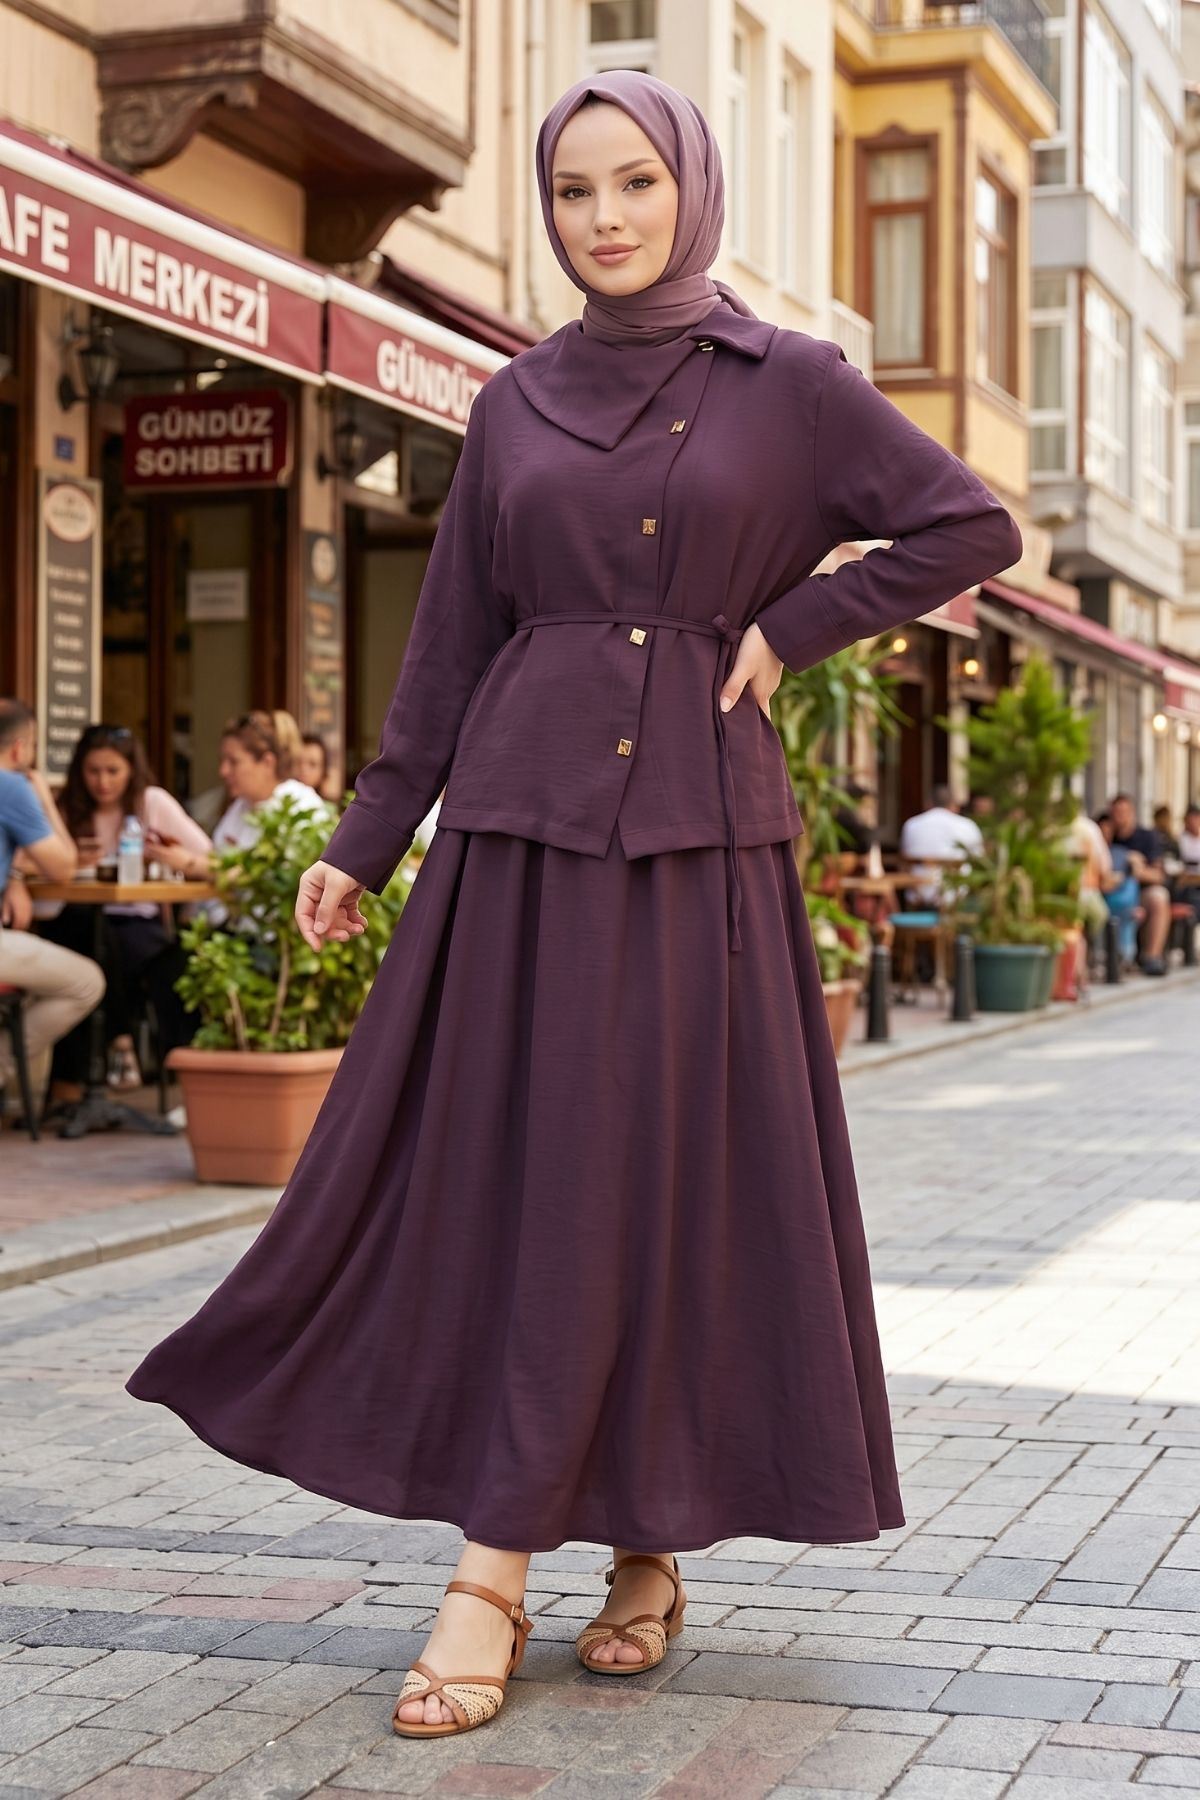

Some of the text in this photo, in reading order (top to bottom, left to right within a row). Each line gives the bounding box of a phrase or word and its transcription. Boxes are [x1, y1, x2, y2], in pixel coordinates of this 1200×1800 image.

[94, 226, 268, 348] MERKEZİ
[138, 403, 273, 441] GÜNDÜZ
[135, 437, 273, 477] SOHBETİ
